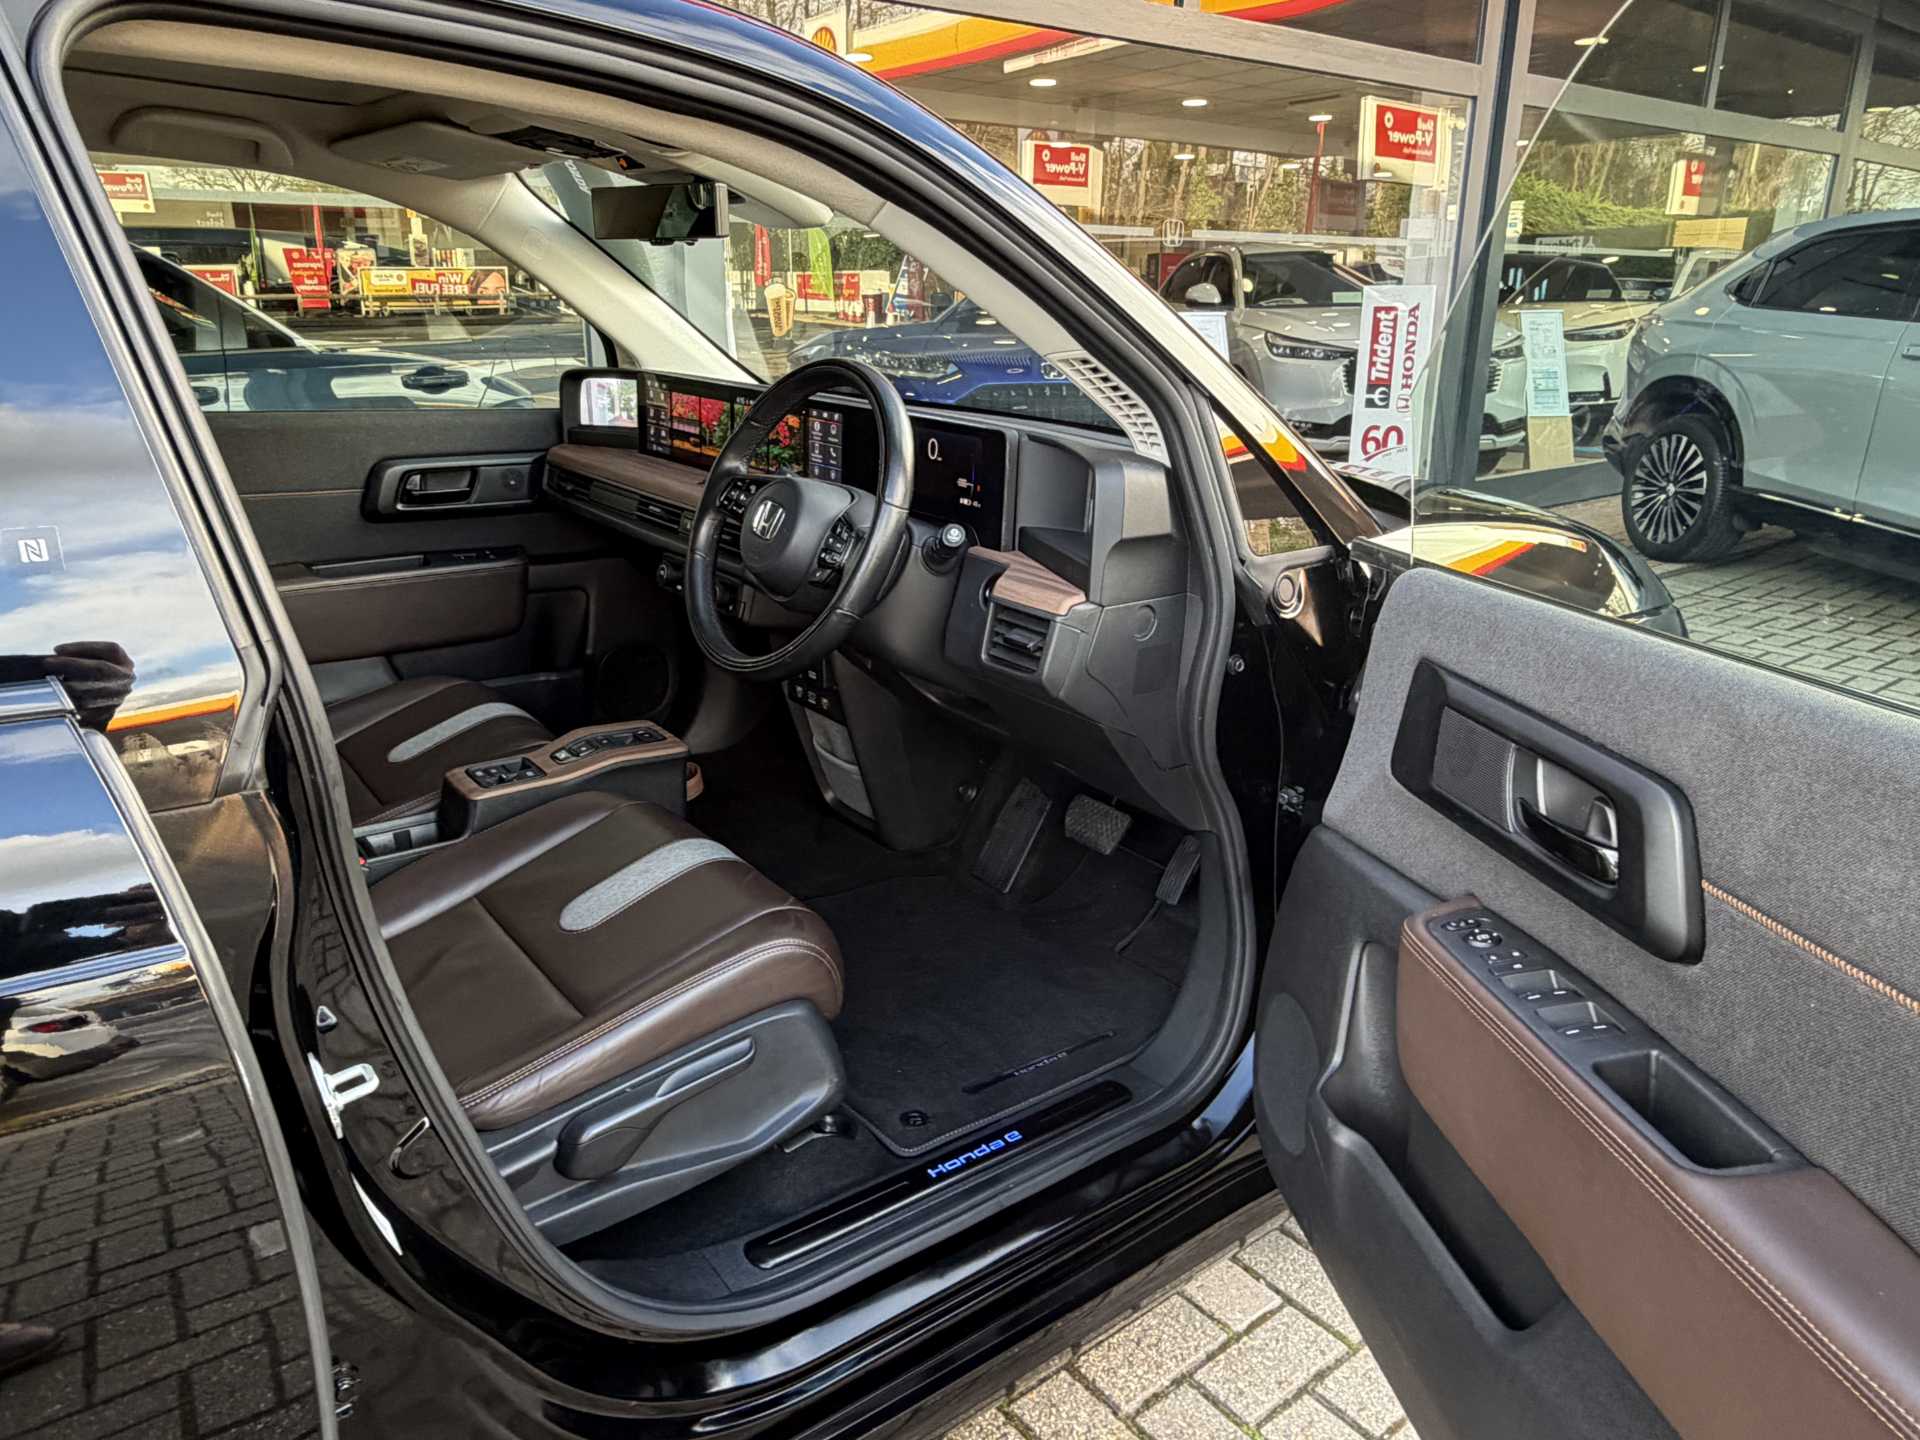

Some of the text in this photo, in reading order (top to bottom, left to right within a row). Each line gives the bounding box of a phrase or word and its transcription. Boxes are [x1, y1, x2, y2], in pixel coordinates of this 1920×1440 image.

[1370, 310, 1397, 382] Trident
[1401, 303, 1421, 391] HONDA
[927, 437, 939, 461] 0
[1361, 425, 1404, 457] 60
[927, 1129, 1023, 1178] Honda e
